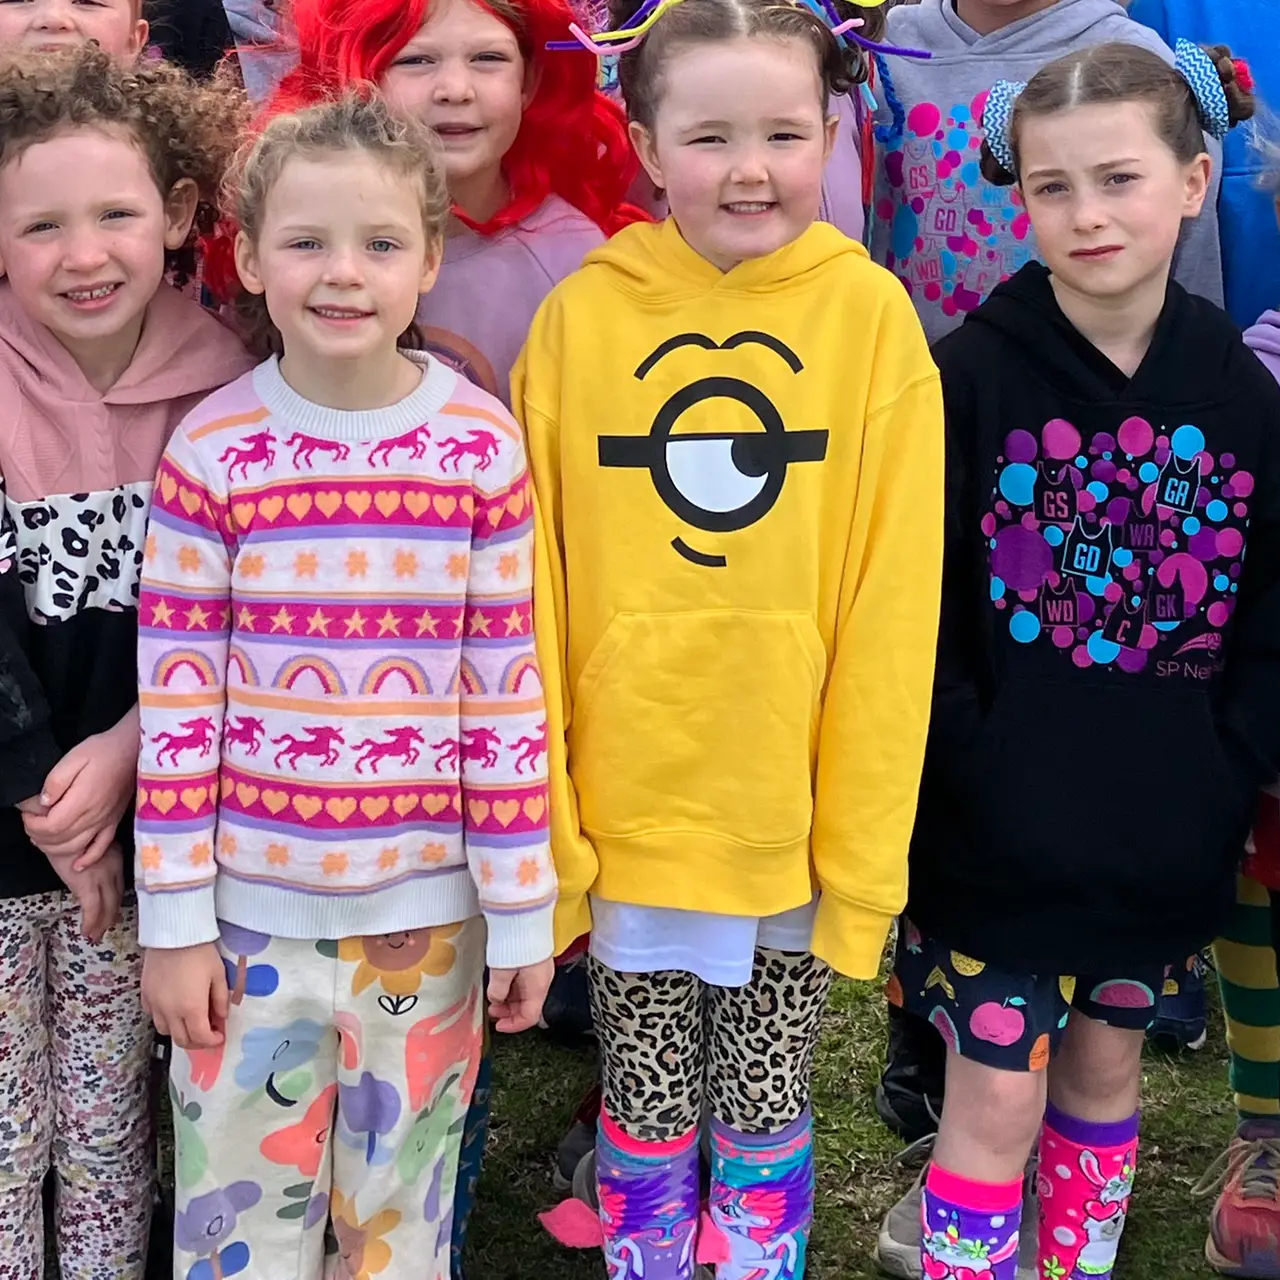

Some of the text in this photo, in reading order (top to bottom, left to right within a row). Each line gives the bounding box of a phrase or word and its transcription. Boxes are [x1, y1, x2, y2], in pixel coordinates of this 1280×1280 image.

[1043, 490, 1069, 518] GS
[1164, 477, 1190, 507] GA
[1129, 523, 1155, 547] WA
[1073, 543, 1101, 572] GD
[1046, 600, 1074, 622] WD
[1155, 594, 1177, 618] GK
[1116, 620, 1131, 642] C
[1156, 660, 1180, 677] SP
